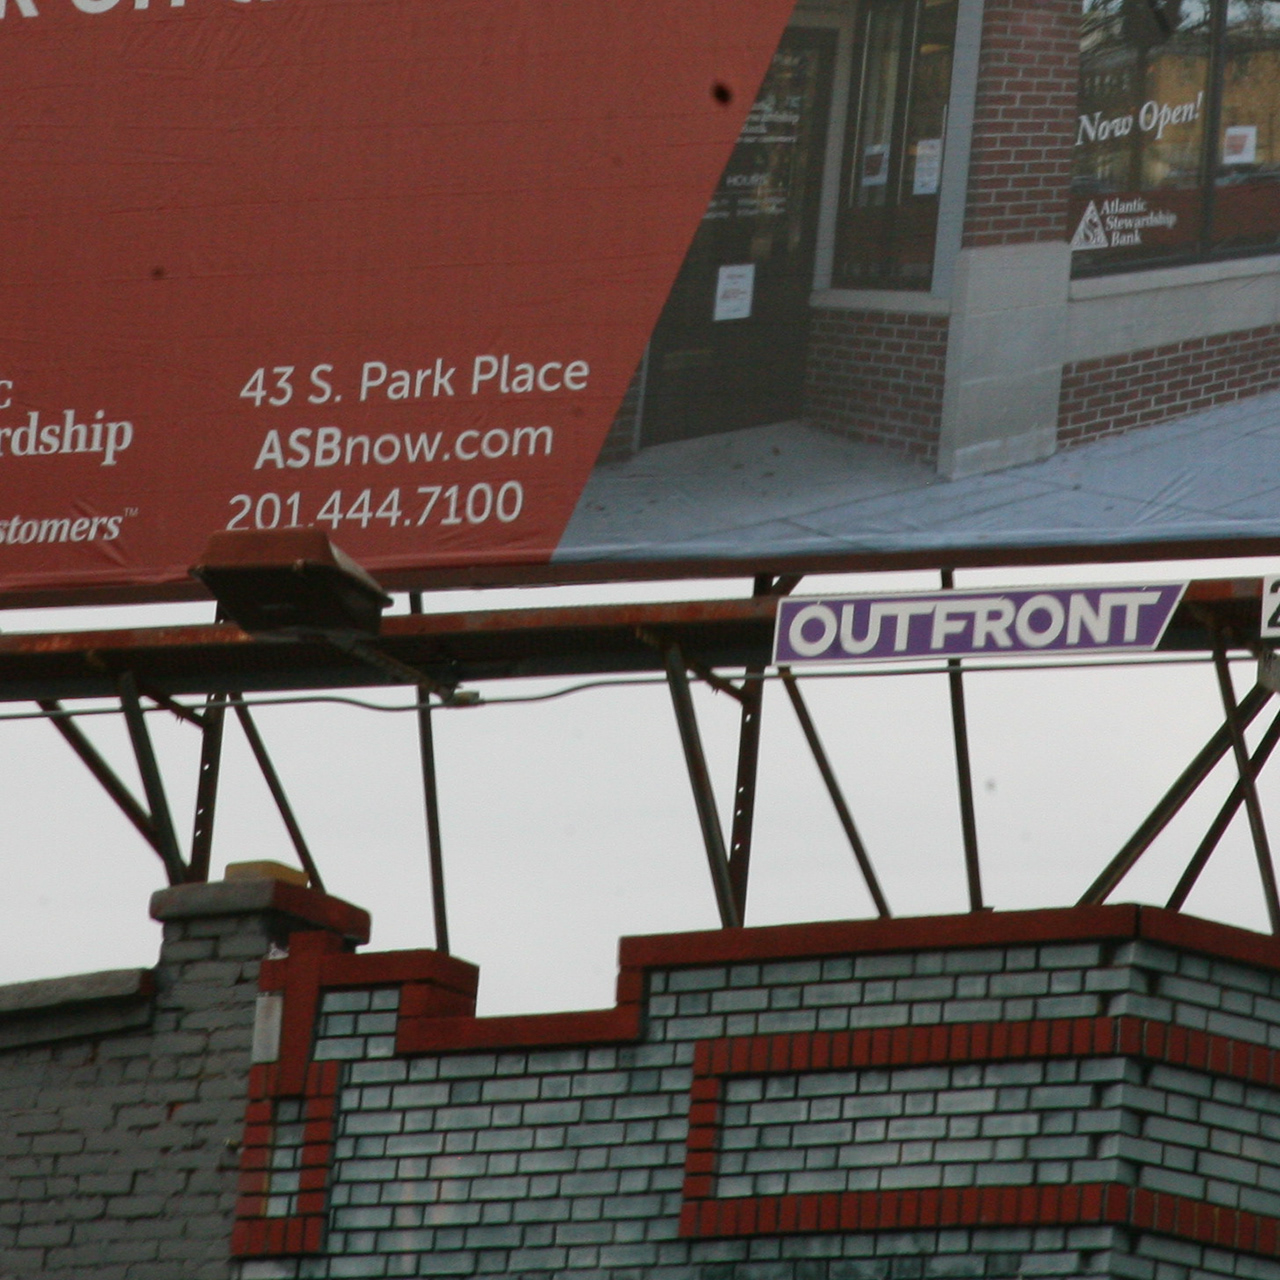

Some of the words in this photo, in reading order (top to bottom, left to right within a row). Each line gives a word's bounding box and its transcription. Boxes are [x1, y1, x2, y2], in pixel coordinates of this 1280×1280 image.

[1075, 111, 1133, 146] Now
[1139, 90, 1204, 140] Open!
[1100, 197, 1147, 215] Atlantic
[1111, 229, 1142, 247] Bank
[239, 365, 296, 407] 43
[308, 362, 343, 405] S.
[359, 358, 456, 402] Park
[471, 354, 591, 396] Place
[254, 425, 554, 470] ASBnow.com
[227, 480, 524, 531] 201.444.7100
[788, 588, 1162, 659] OUTFRONT
